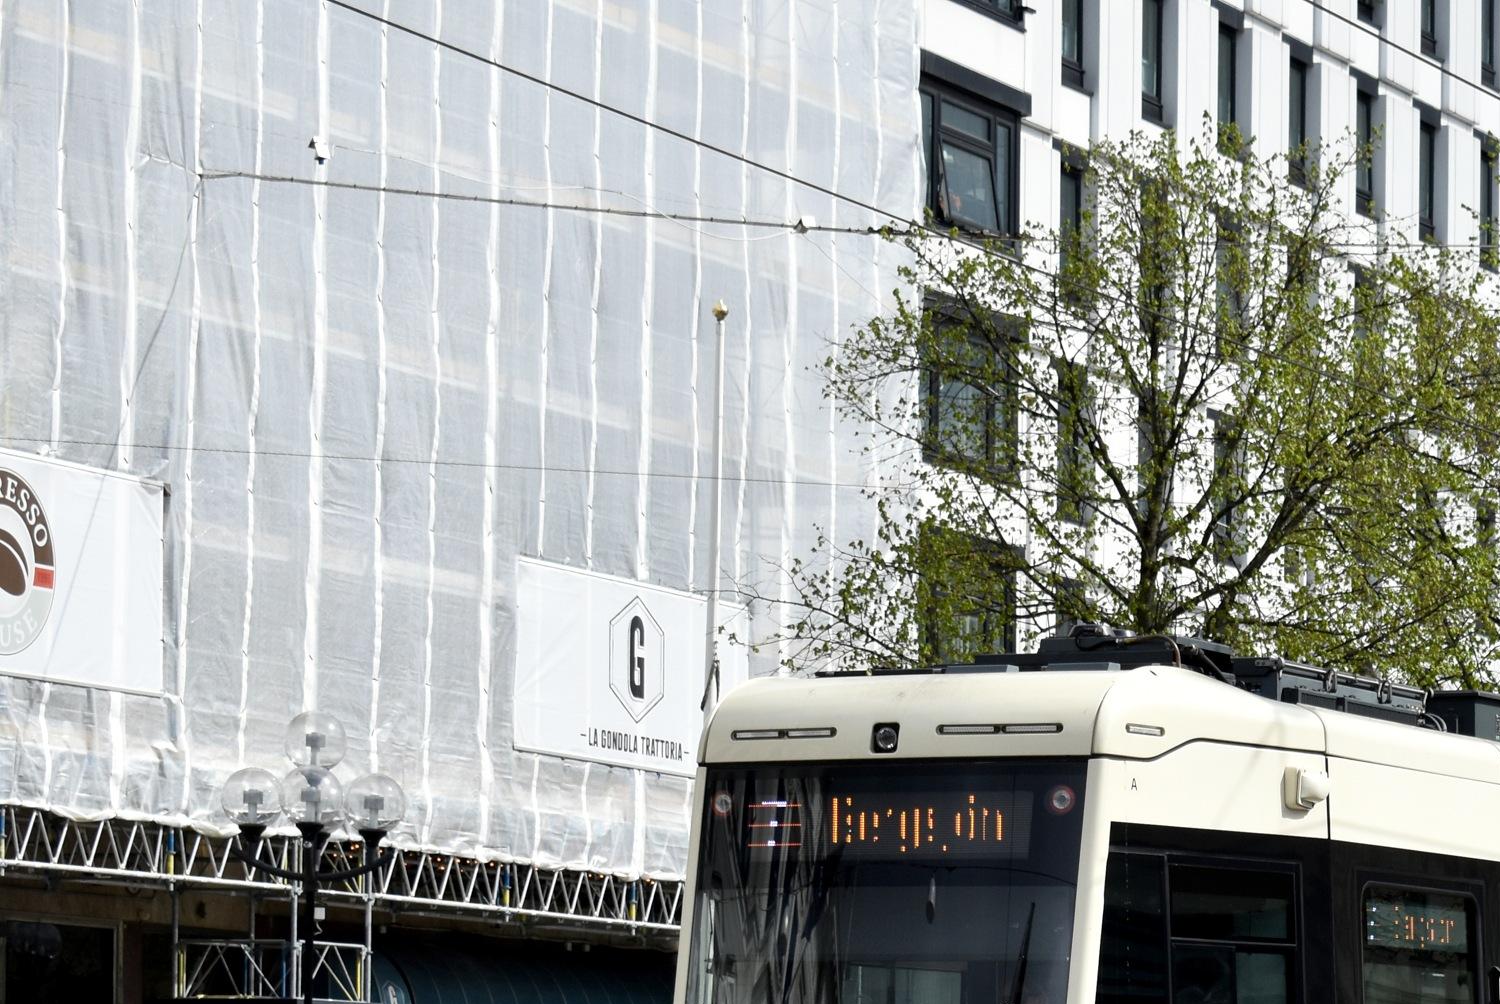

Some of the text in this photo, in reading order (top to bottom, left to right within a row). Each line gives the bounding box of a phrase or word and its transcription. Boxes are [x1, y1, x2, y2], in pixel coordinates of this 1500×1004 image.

[629, 615, 645, 700] G
[588, 727, 684, 761] LA GONDOLA TRATTORIA
